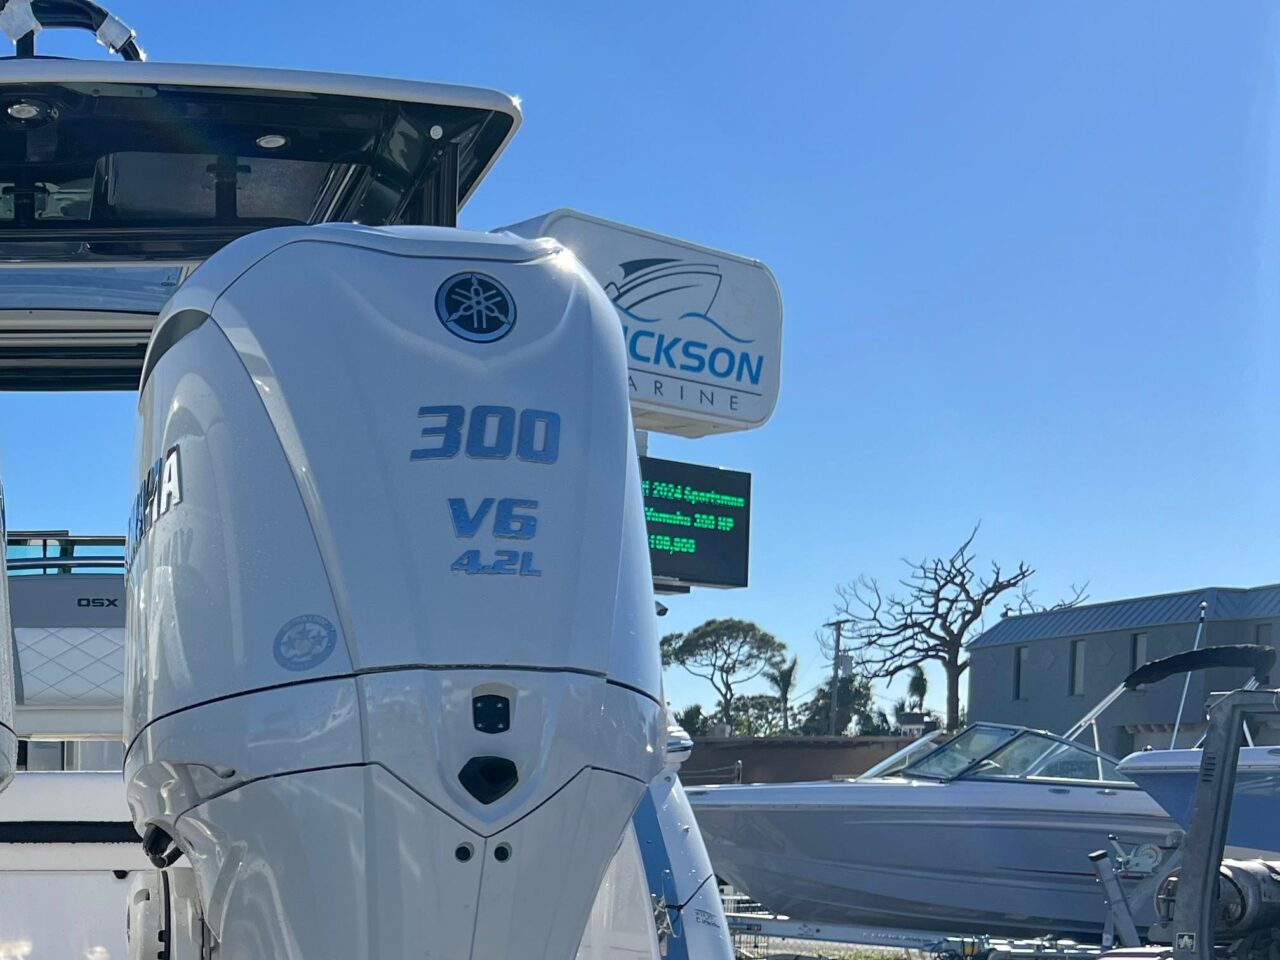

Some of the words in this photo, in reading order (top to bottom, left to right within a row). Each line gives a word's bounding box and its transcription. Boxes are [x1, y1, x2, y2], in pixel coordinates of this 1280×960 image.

[409, 405, 561, 465] 300
[652, 481, 682, 500] 2024
[447, 498, 538, 540] V6
[717, 516, 735, 531] HP
[450, 549, 542, 577] 4.2L
[77, 598, 119, 608] OSX
